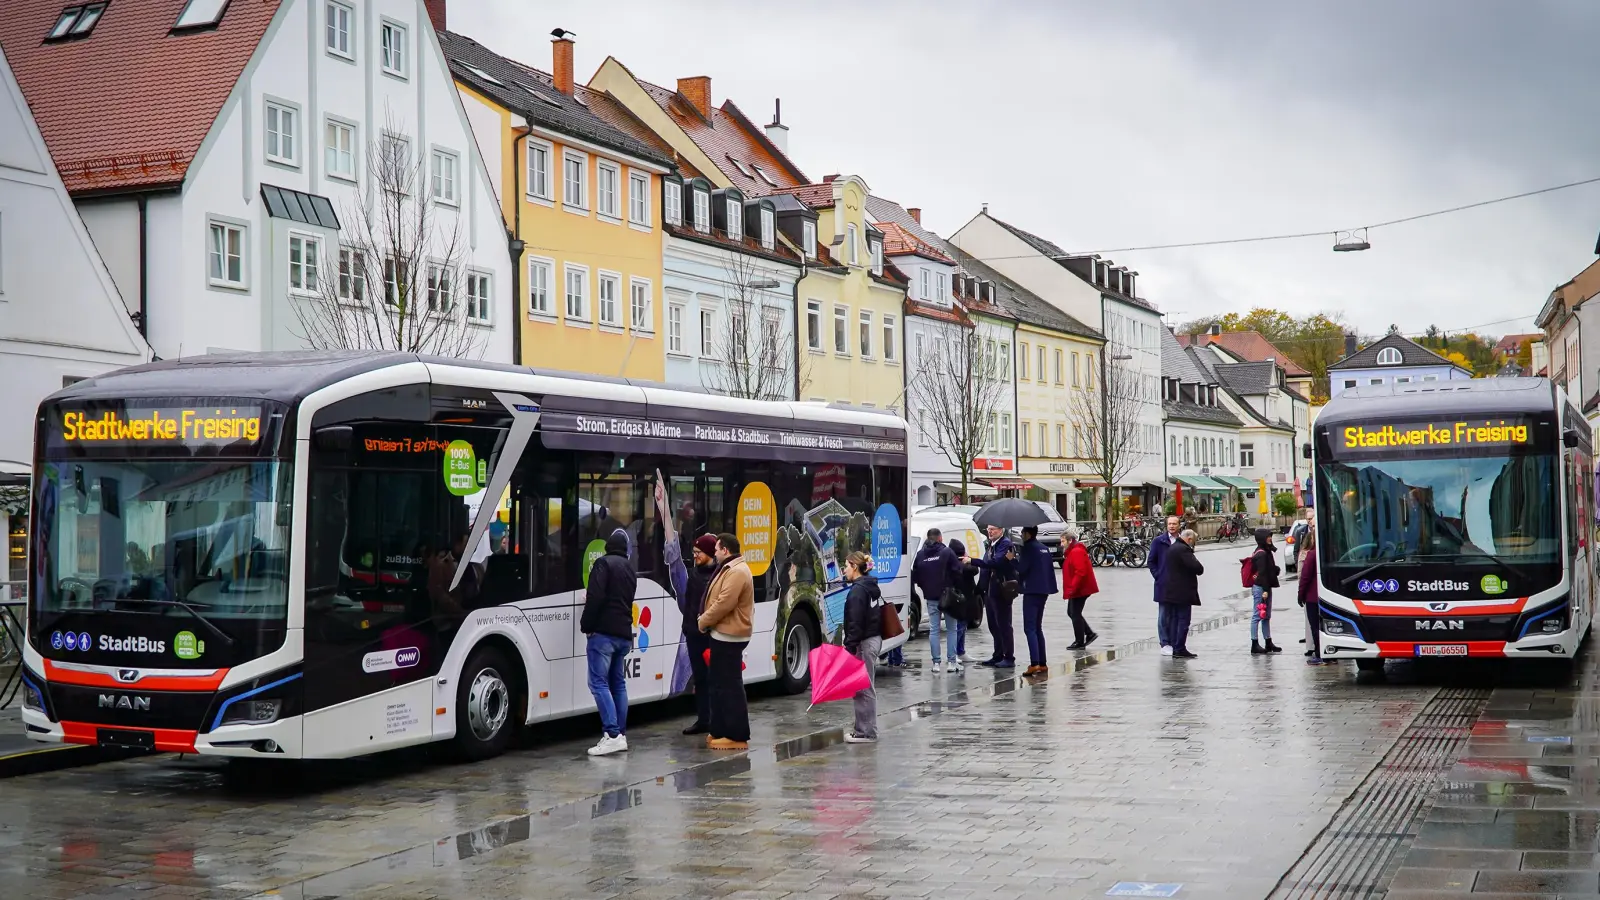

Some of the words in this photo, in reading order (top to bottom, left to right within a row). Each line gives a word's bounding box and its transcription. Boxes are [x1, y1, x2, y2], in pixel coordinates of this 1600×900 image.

[462, 399, 487, 408] MAN
[63, 411, 177, 440] Stadtwerke
[181, 410, 260, 441] Freising
[576, 416, 609, 434] Strom,
[611, 419, 642, 439] Erdgas
[643, 422, 650, 436] &
[651, 422, 681, 438] Wärme
[695, 425, 730, 441] Parkhaus
[731, 429, 737, 442] &
[738, 428, 769, 444] Stadtbus
[779, 432, 818, 447] Trinkwasser
[818, 436, 824, 448] &
[824, 437, 843, 449] fresch
[1344, 424, 1451, 448] Stadtwerke
[1454, 421, 1527, 444] Freising
[450, 448, 471, 459] 100%
[450, 460, 470, 470] E-Bus
[743, 498, 762, 511] DEIN
[877, 516, 889, 530] Dein
[743, 532, 769, 546] UNSER
[743, 548, 767, 562] WERK.
[877, 547, 898, 560] UNSER
[877, 561, 892, 574] BAD.
[1407, 579, 1470, 591] StadtBus
[1415, 620, 1465, 630] MAN
[99, 635, 166, 653] StadtBus
[1421, 646, 1437, 654] WUG
[1440, 646, 1465, 655] 06550
[98, 694, 151, 710] MAN
